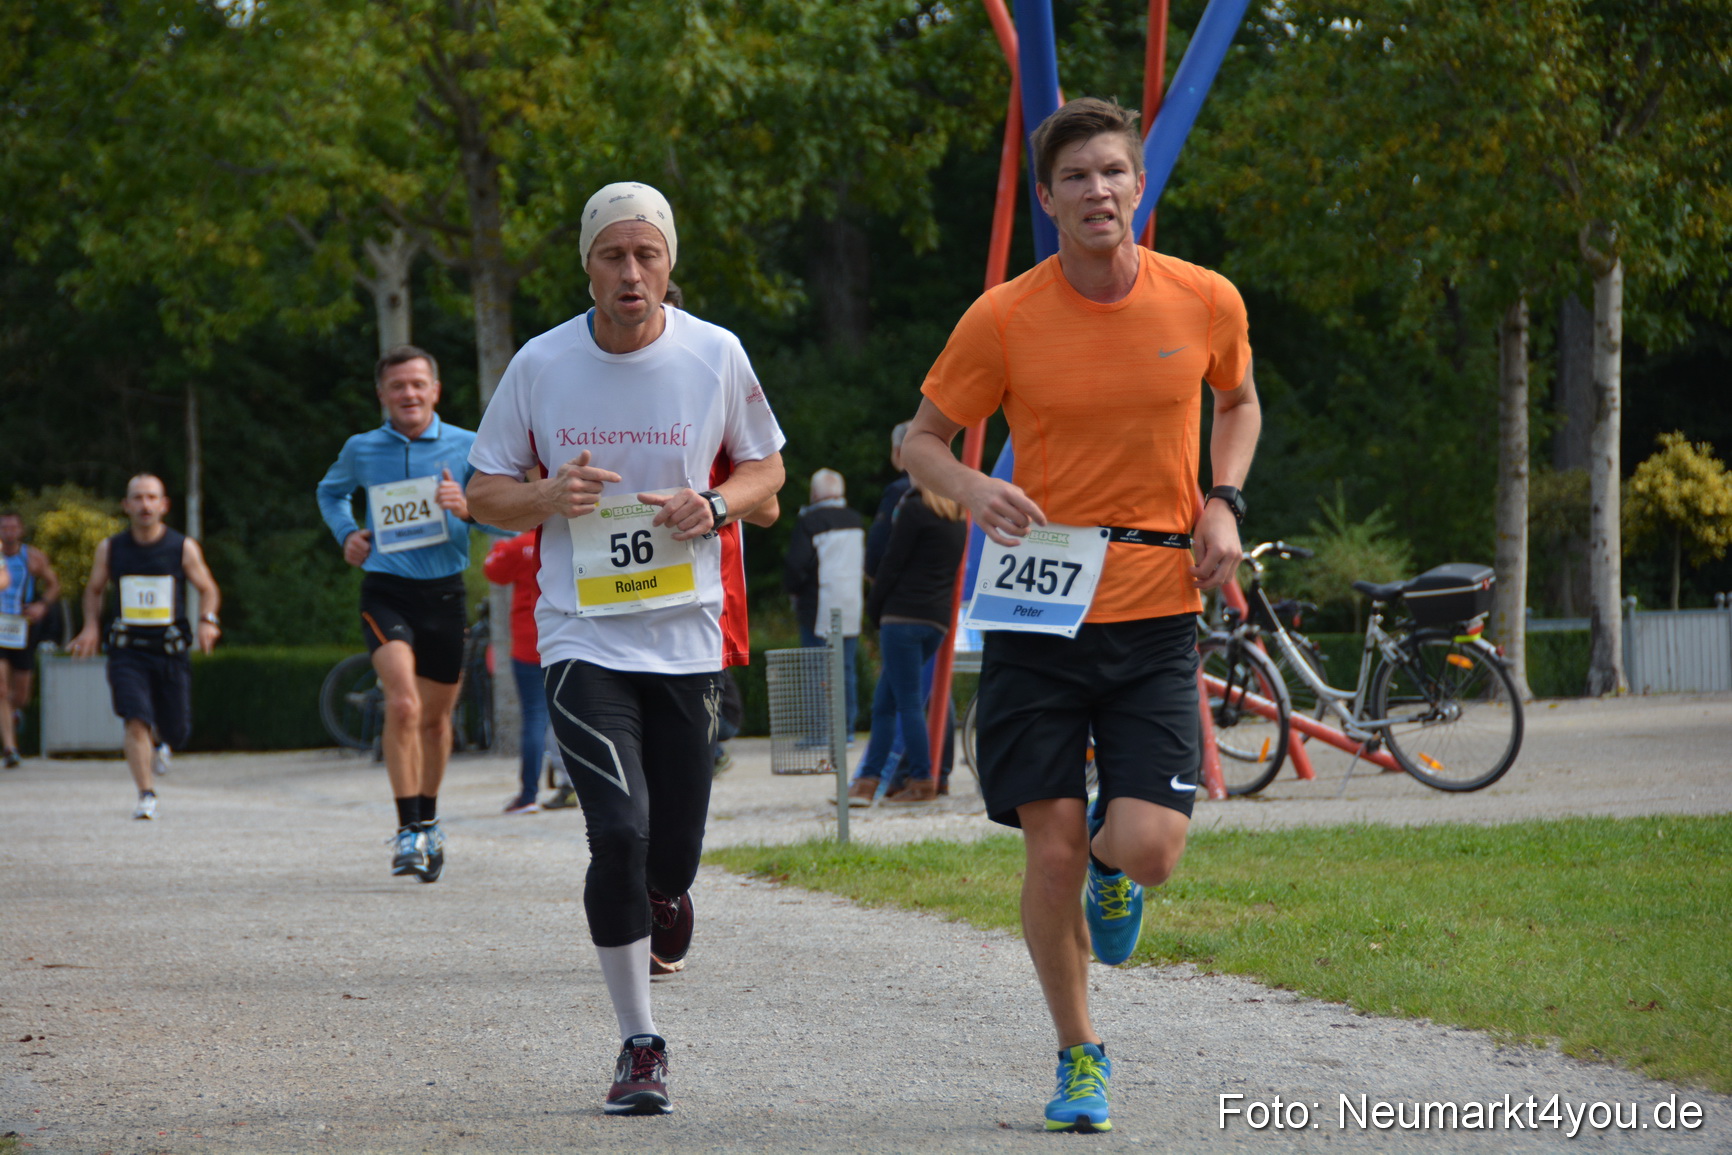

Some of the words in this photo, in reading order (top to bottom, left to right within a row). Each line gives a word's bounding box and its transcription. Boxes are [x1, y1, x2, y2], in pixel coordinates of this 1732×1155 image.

[556, 423, 692, 447] Kaiserwinkl
[381, 499, 431, 526] 2024
[613, 504, 654, 517] BOCK
[1029, 530, 1070, 545] BOCK
[610, 530, 654, 568] 56
[995, 553, 1082, 597] 2457
[615, 576, 658, 593] Roland
[138, 591, 155, 606] 10
[1013, 605, 1044, 618] Peter
